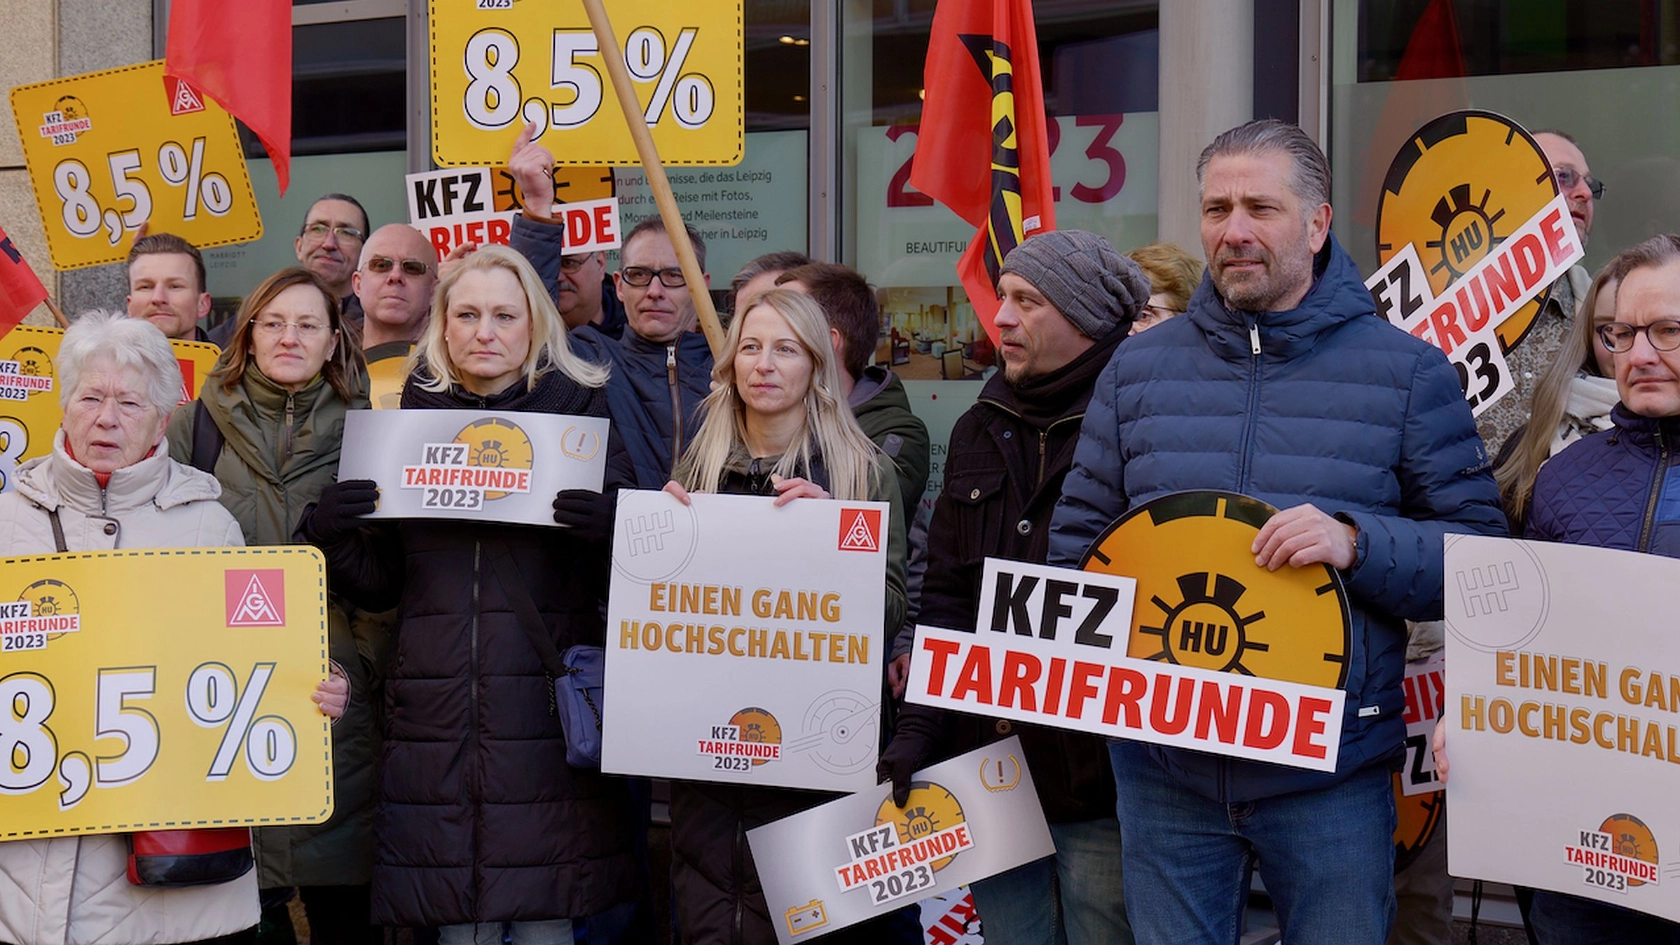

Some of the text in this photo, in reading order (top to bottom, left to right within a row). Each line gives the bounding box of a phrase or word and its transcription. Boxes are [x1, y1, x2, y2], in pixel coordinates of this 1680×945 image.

[463, 26, 715, 143] 8,5 %
[41, 119, 90, 136] TARIFRUNDE
[45, 113, 62, 124] KFZ
[53, 132, 76, 145] 2023
[624, 176, 643, 186] und
[699, 172, 714, 184] die
[716, 171, 734, 182] das
[736, 169, 772, 184] Leipzig
[53, 136, 233, 246] 8,5 %
[414, 172, 484, 219] KFZ
[618, 194, 646, 205] durch
[701, 190, 718, 202] mit
[721, 189, 753, 201] Fotos,
[695, 208, 758, 221] Meilensteine
[720, 228, 730, 238] in
[732, 227, 768, 241] Leipzig
[1450, 220, 1483, 264] HU
[1370, 258, 1424, 321] FZ
[425, 446, 464, 465] KFZ
[482, 454, 497, 464] HU
[405, 468, 528, 490] TARIFRUNDE
[426, 488, 480, 508] 2023
[0, 604, 28, 618] KFZ
[650, 582, 841, 622] EINEN GANG
[990, 572, 1120, 649] KFZ
[5, 634, 44, 650] 2023
[619, 620, 869, 664] HOCHSCHALTEN
[1179, 620, 1228, 656] HU
[1496, 649, 1607, 699] EINEN
[923, 638, 1332, 760] TARIFRUNDE
[0, 661, 297, 811] 8,5 %
[712, 726, 736, 740] KFZ
[698, 740, 780, 758] TARIFRUNDE
[714, 756, 750, 770] 2023
[912, 822, 928, 835] HU
[851, 826, 894, 859] KFZ
[1580, 831, 1609, 852] KFZ
[838, 826, 970, 888] TARIFRUNDE
[1565, 846, 1657, 882] TARIFRUNDE
[872, 866, 931, 902] 2023
[1585, 868, 1625, 890] 2023
